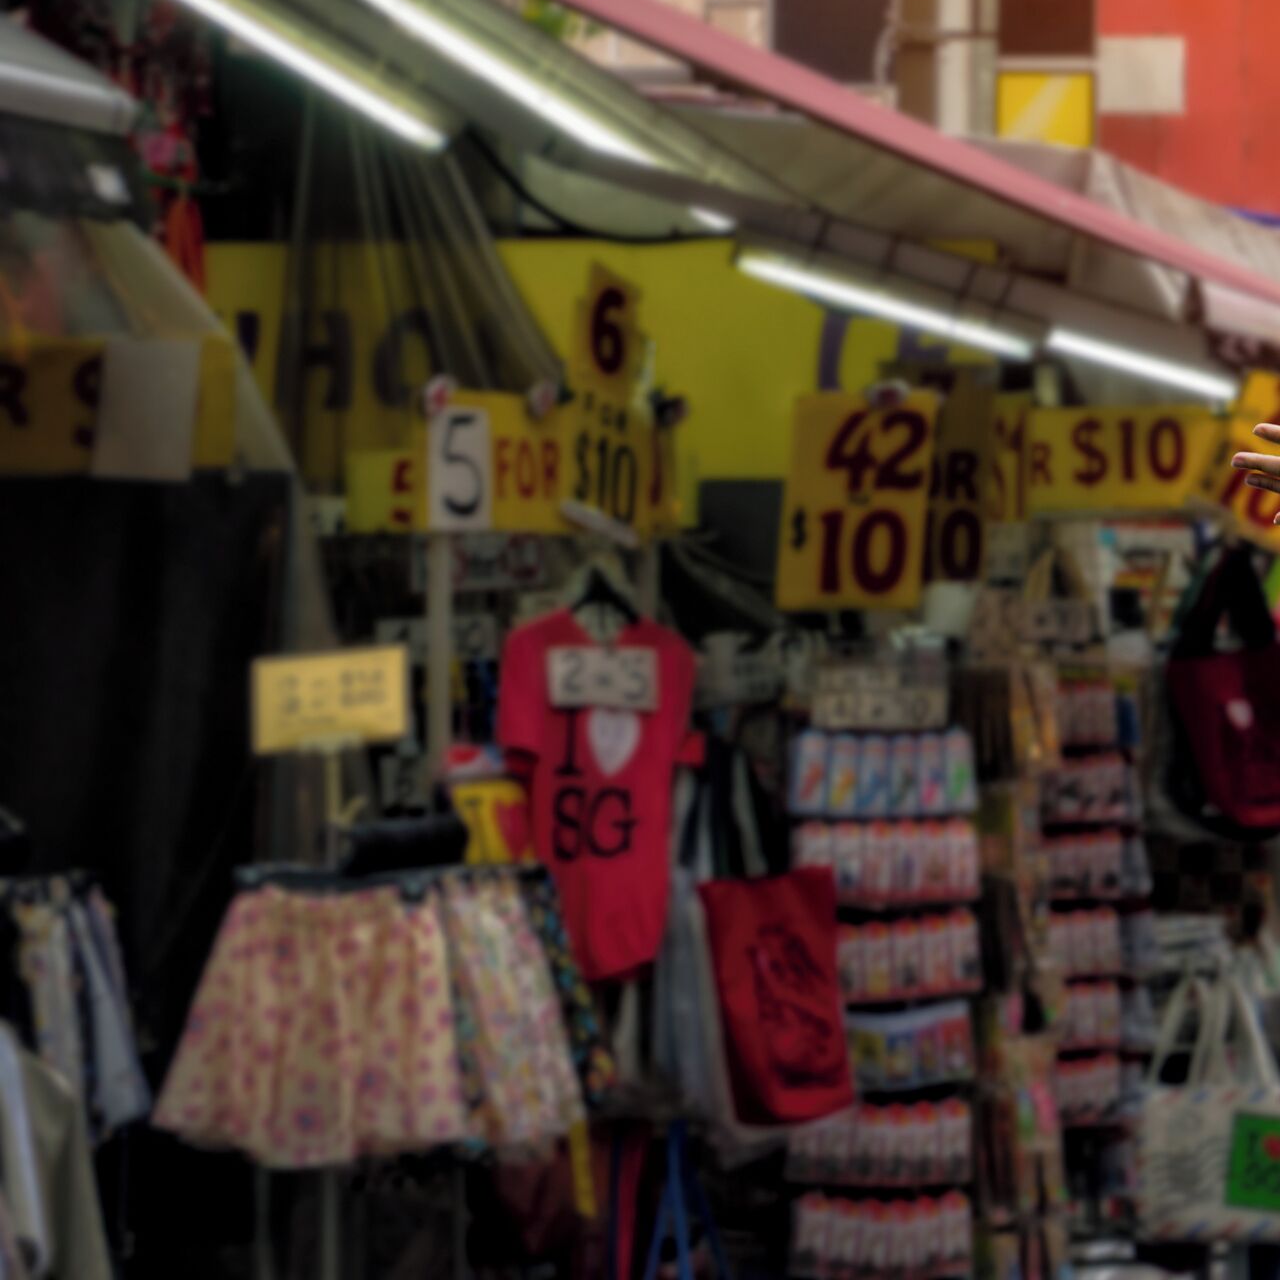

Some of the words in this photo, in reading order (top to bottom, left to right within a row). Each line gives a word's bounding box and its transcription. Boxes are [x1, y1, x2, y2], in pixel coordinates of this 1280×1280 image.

[592, 287, 626, 373] 6
[442, 415, 482, 516] 5
[496, 435, 562, 499] FOR
[574, 431, 638, 523] $10
[825, 408, 929, 493] 42
[1072, 415, 1186, 487] $10
[553, 786, 636, 861] SG
